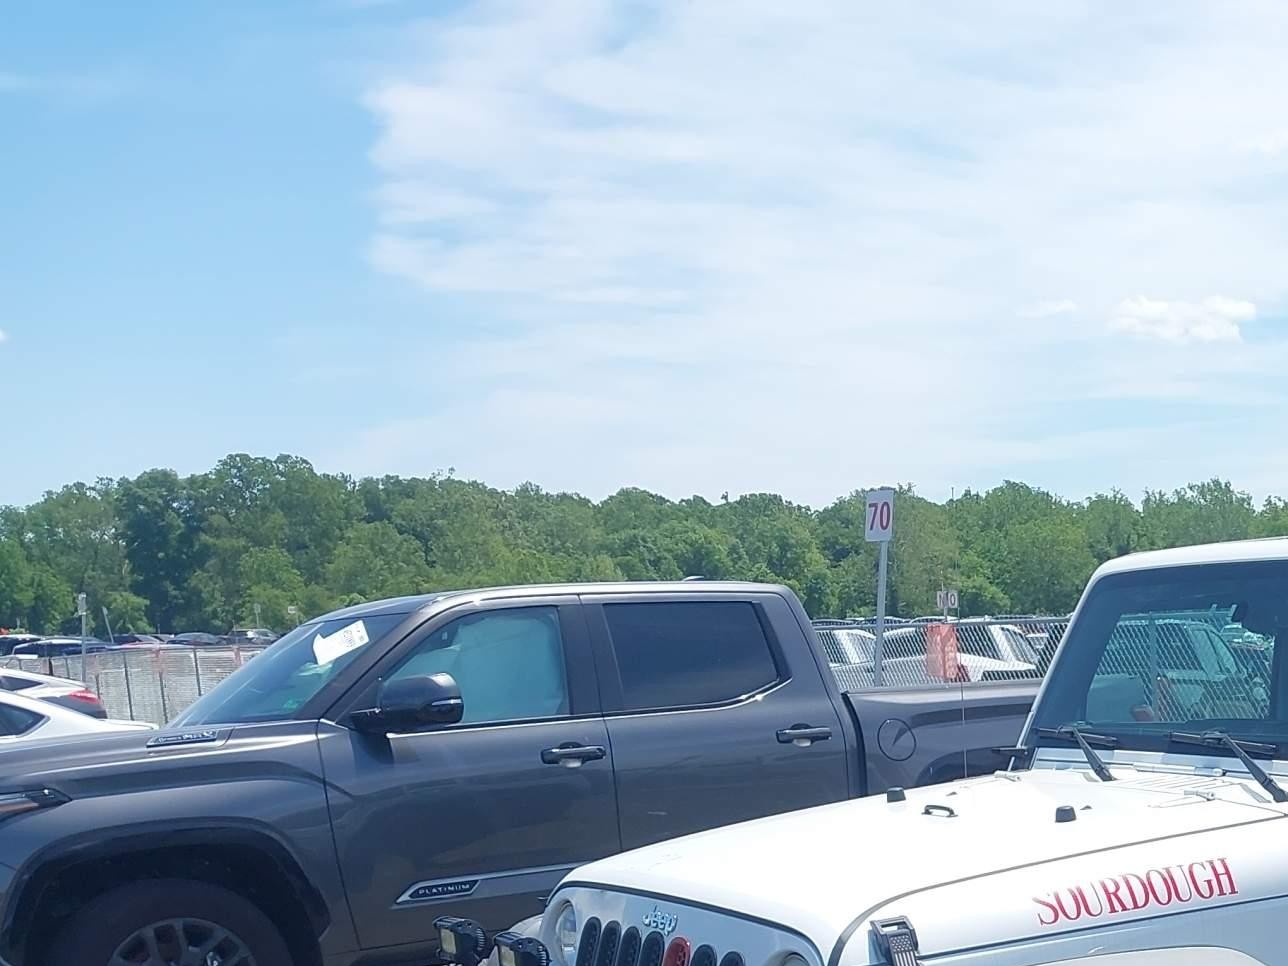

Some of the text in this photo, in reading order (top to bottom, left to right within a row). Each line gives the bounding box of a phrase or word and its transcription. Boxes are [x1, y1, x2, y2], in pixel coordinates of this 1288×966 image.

[868, 501, 891, 531] 70
[418, 884, 470, 895] PLATINUM
[1032, 857, 1239, 926] SOURDOUGH
[642, 904, 679, 937] Jeep
